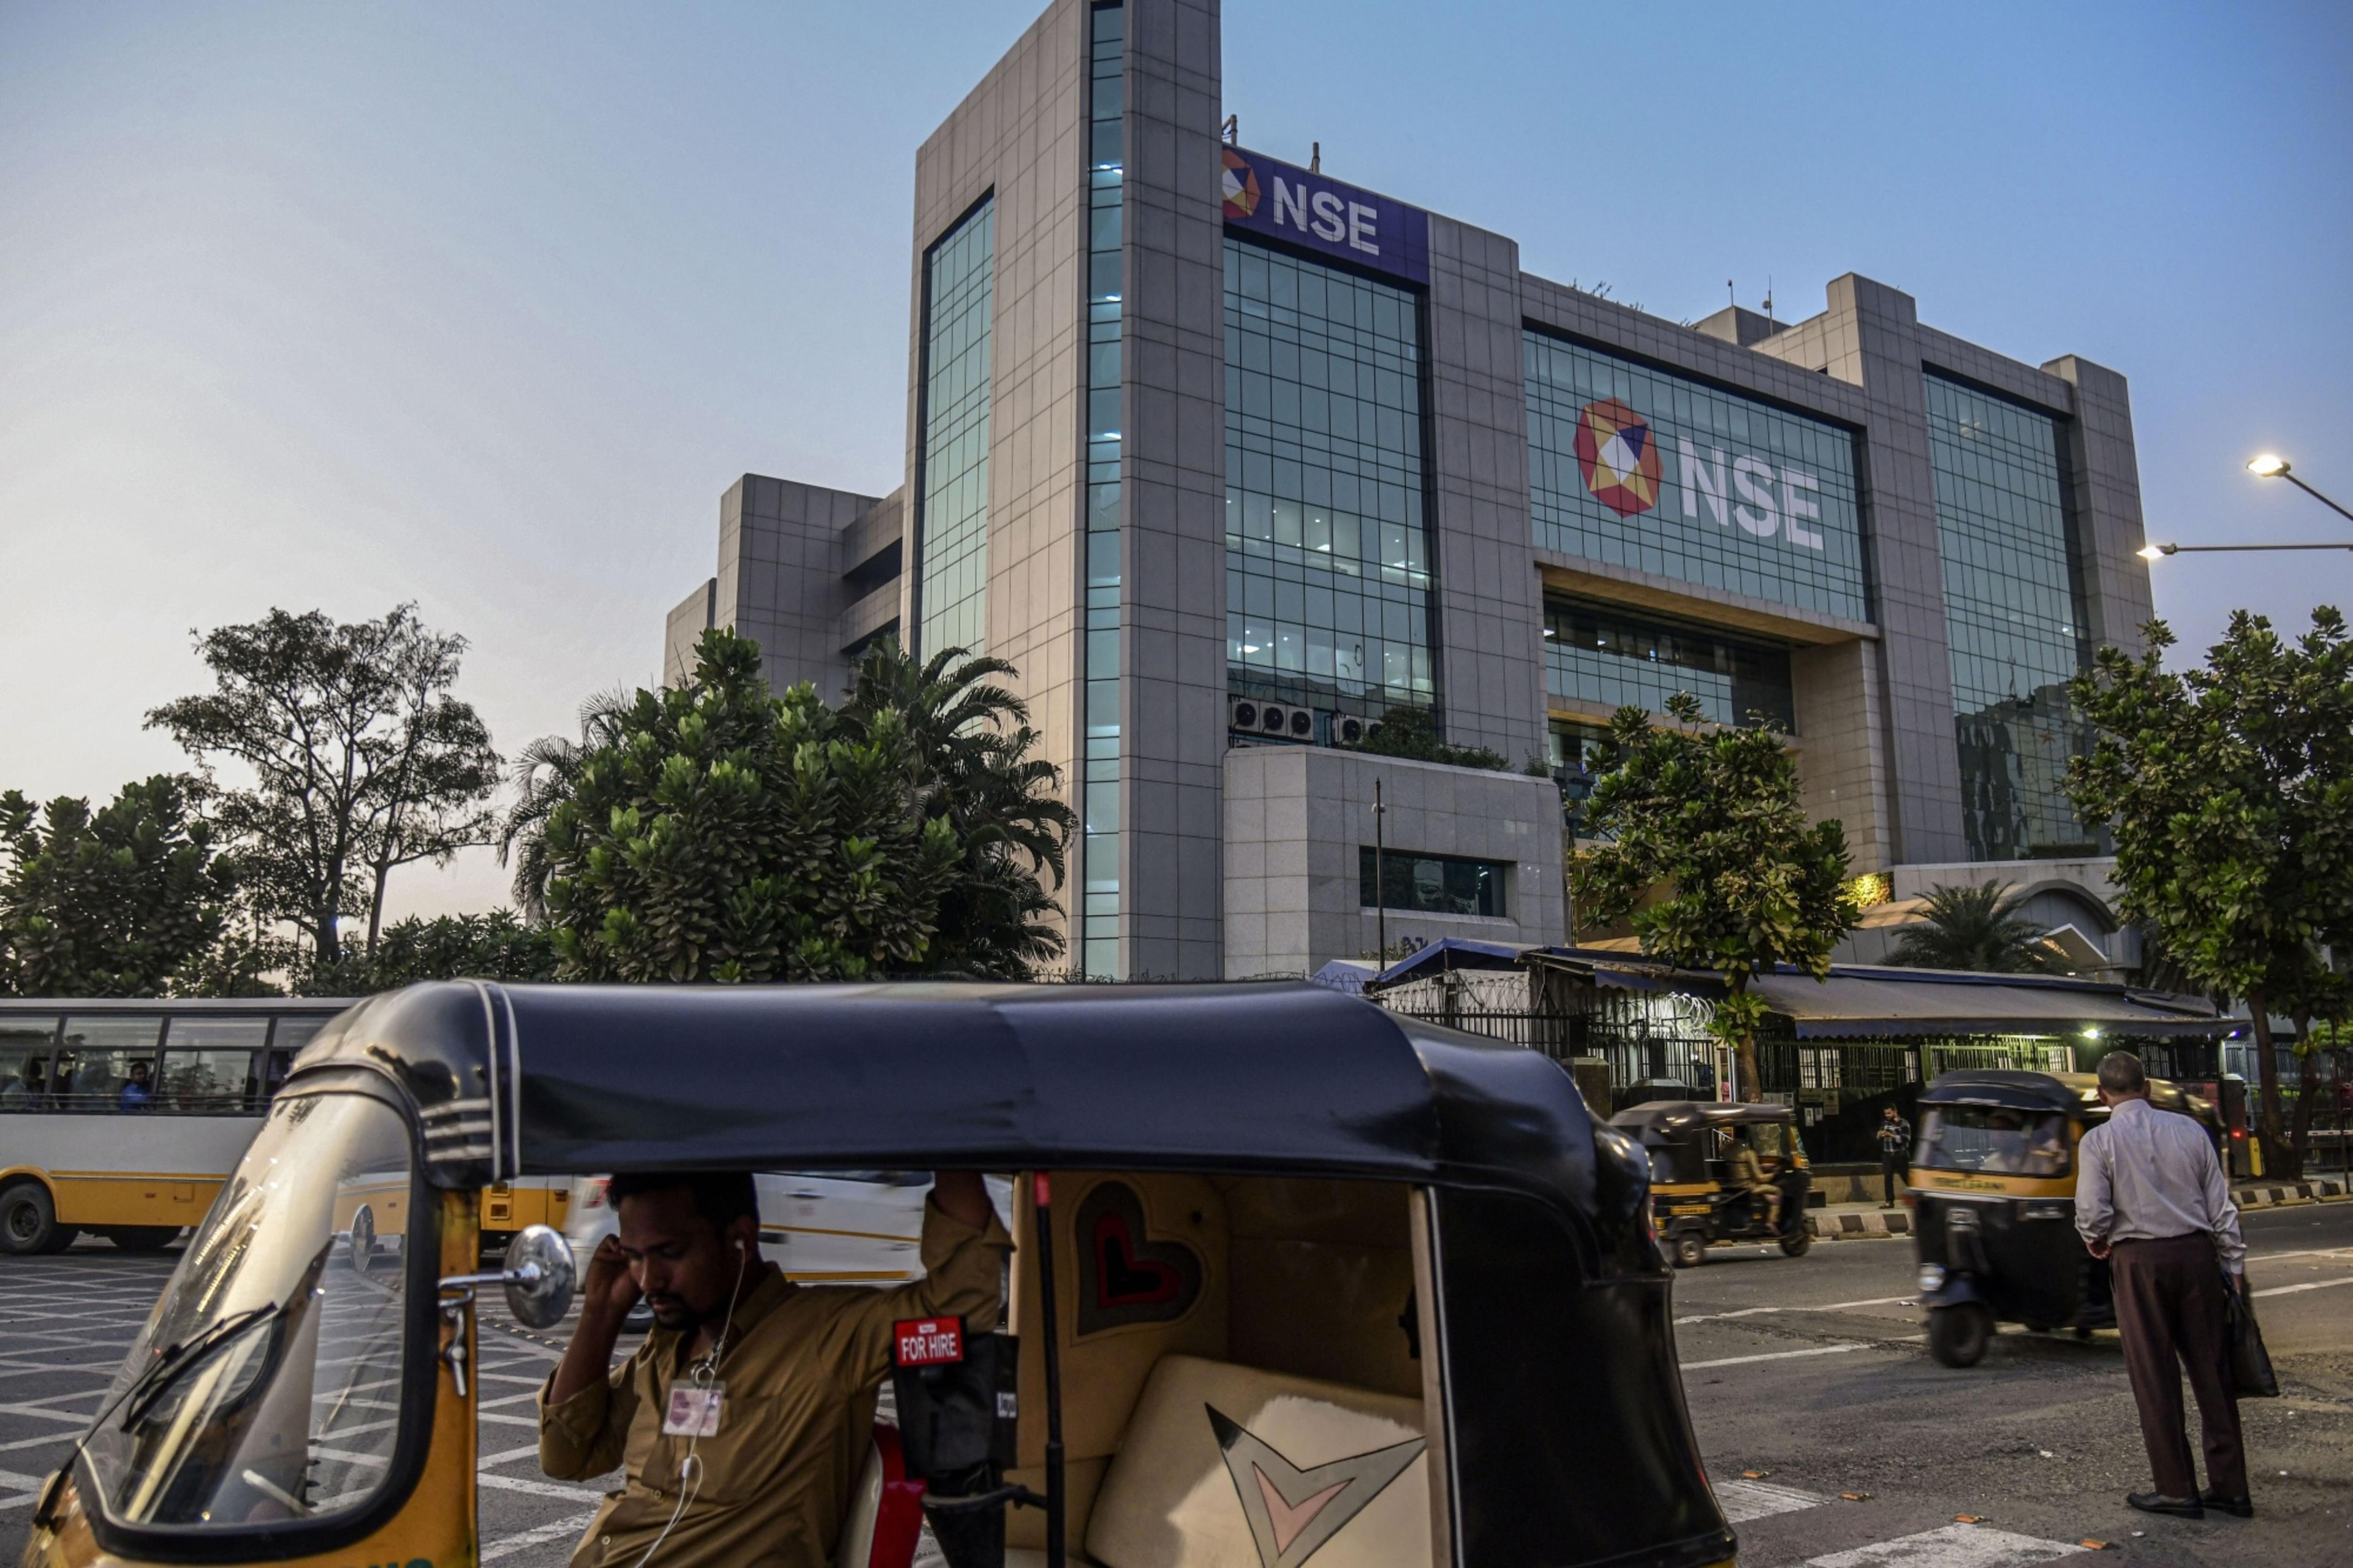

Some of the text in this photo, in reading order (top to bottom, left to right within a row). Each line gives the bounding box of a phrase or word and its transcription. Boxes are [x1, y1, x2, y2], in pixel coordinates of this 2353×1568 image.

[1274, 176, 1379, 256] NSE
[1678, 436, 1824, 550] NSE
[901, 1333, 957, 1361] FOR HIRE
